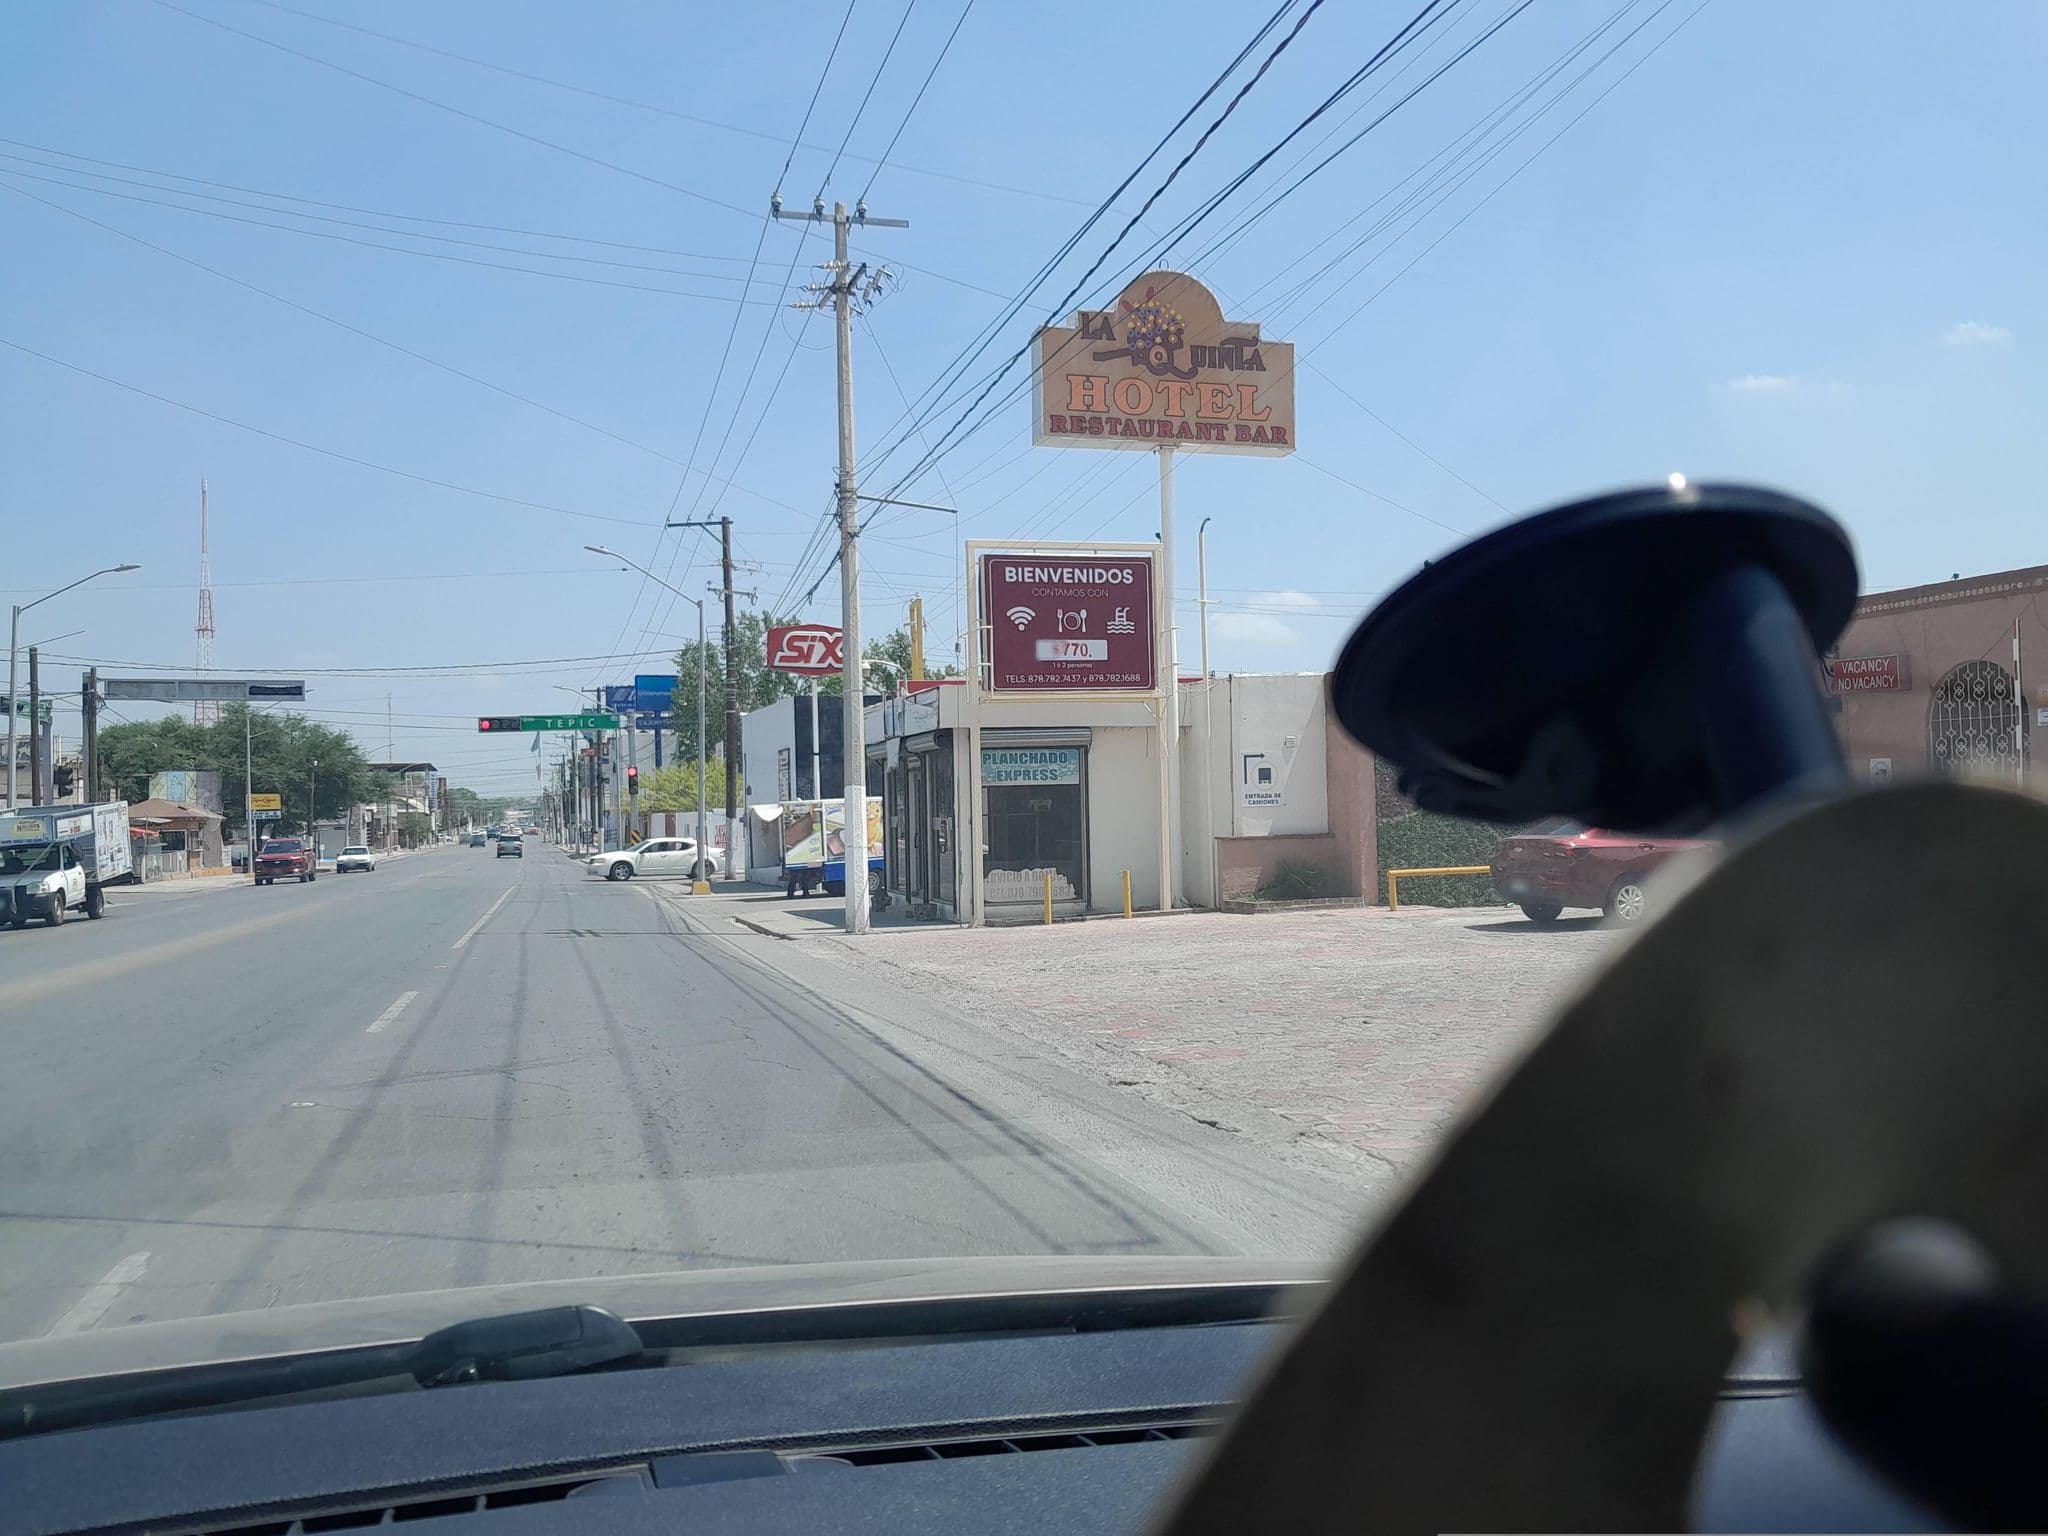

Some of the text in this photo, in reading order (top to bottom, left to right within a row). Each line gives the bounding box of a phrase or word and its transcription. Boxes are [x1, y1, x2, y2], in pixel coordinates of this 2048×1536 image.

[1080, 312, 1116, 341] LA
[1066, 373, 1272, 422] HOTEL
[1050, 414, 1288, 444] RESTAURANT BAR
[1005, 567, 1134, 584] BIENVENIDOS
[1032, 588, 1109, 598] CONTAMOS CON
[1841, 658, 1890, 674] VACANCY
[1838, 674, 1896, 690] NO VACANCY
[546, 718, 595, 728] TEPIC
[982, 752, 1068, 765] PLANCHADO
[996, 769, 1059, 781] EXPRESS
